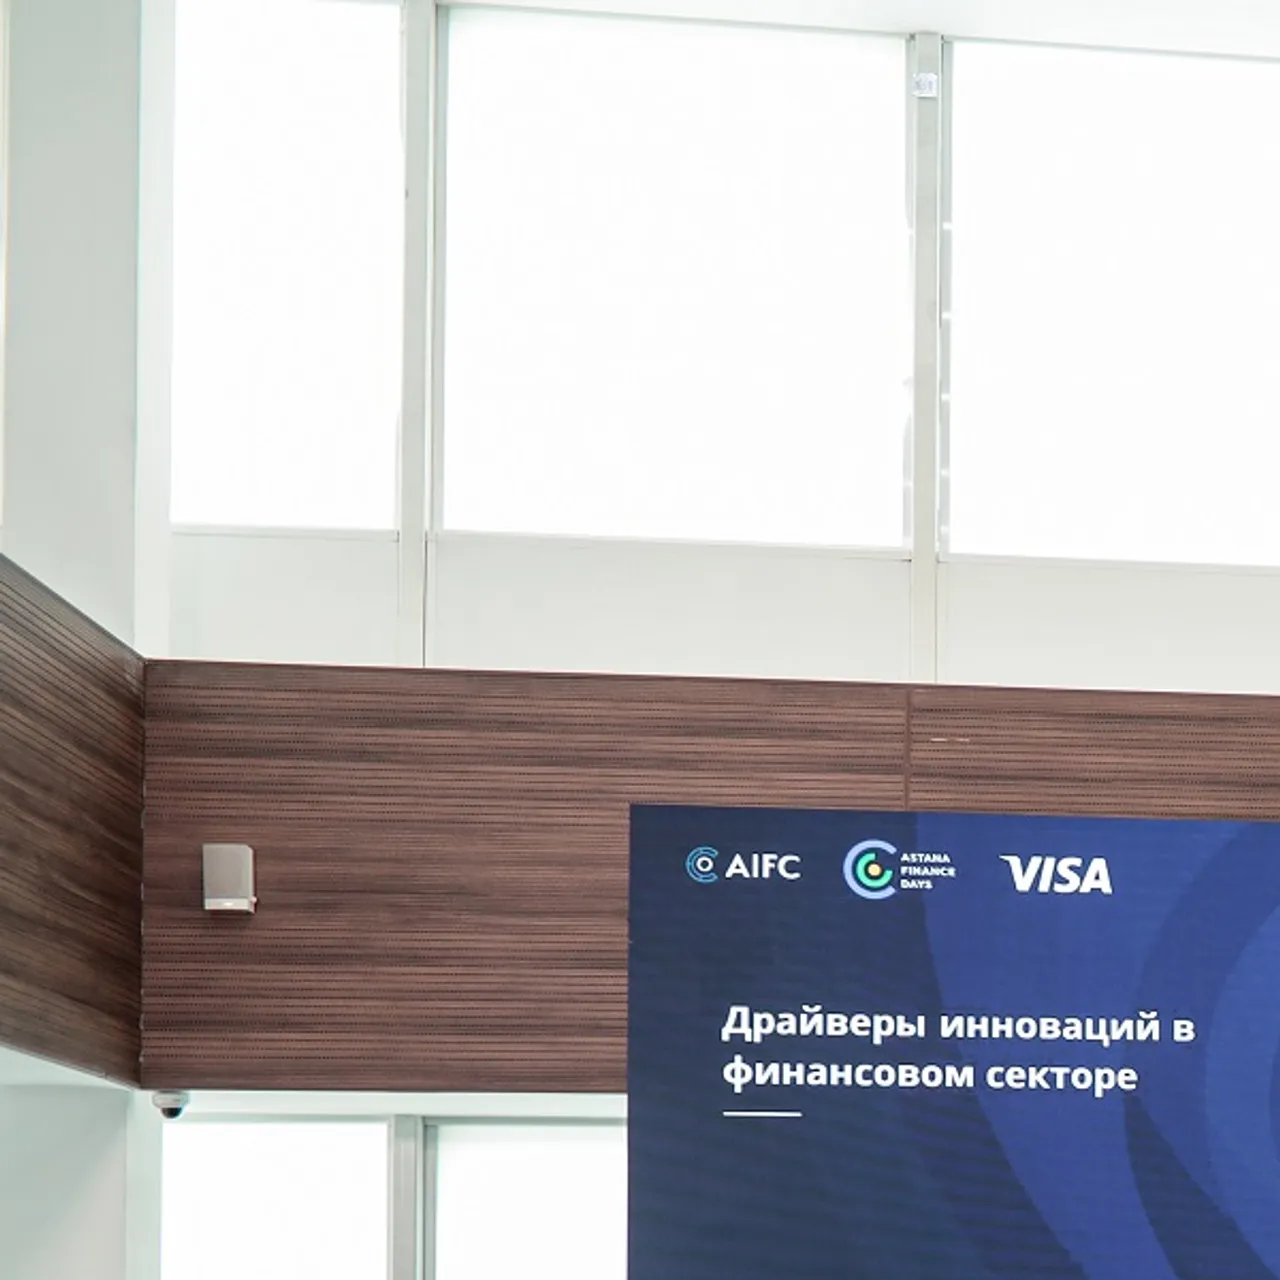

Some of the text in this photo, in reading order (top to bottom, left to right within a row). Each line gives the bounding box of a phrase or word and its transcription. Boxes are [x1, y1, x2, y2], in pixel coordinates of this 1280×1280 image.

[725, 852, 802, 881] AIFC
[900, 853, 950, 864] ASTANA
[900, 866, 957, 877] FINANCE
[900, 879, 934, 889] DAYS
[999, 855, 1113, 895] VISA
[721, 1006, 1196, 1047] Драйверы инноваций в
[722, 1055, 1138, 1098] финансовом секторе
